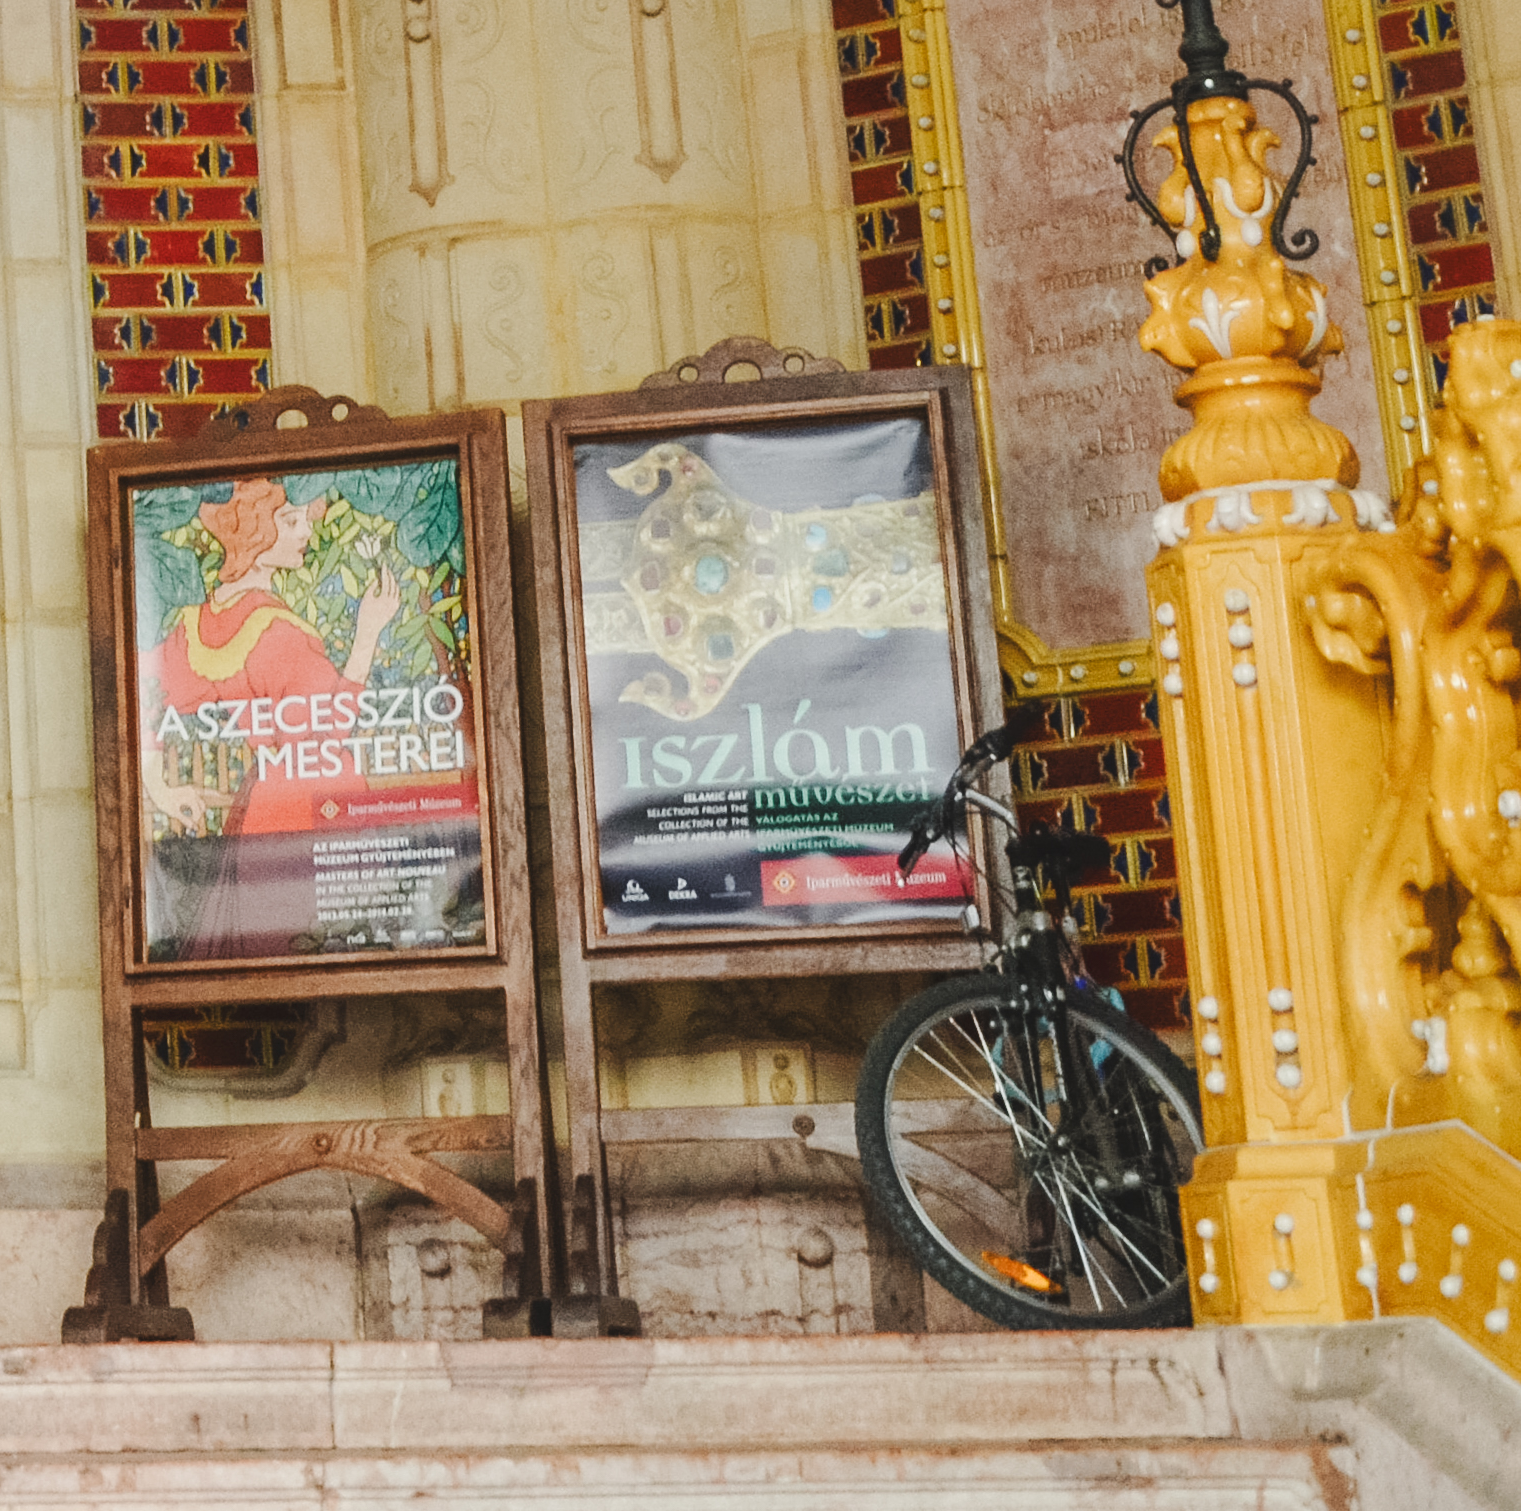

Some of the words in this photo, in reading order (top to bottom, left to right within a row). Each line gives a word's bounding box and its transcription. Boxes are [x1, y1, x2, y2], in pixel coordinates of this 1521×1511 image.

[157, 704, 190, 742] A
[197, 674, 464, 740] SZECESSZIÓ
[257, 731, 465, 781] MESTEREI
[805, 870, 891, 891] Iparművészeti
